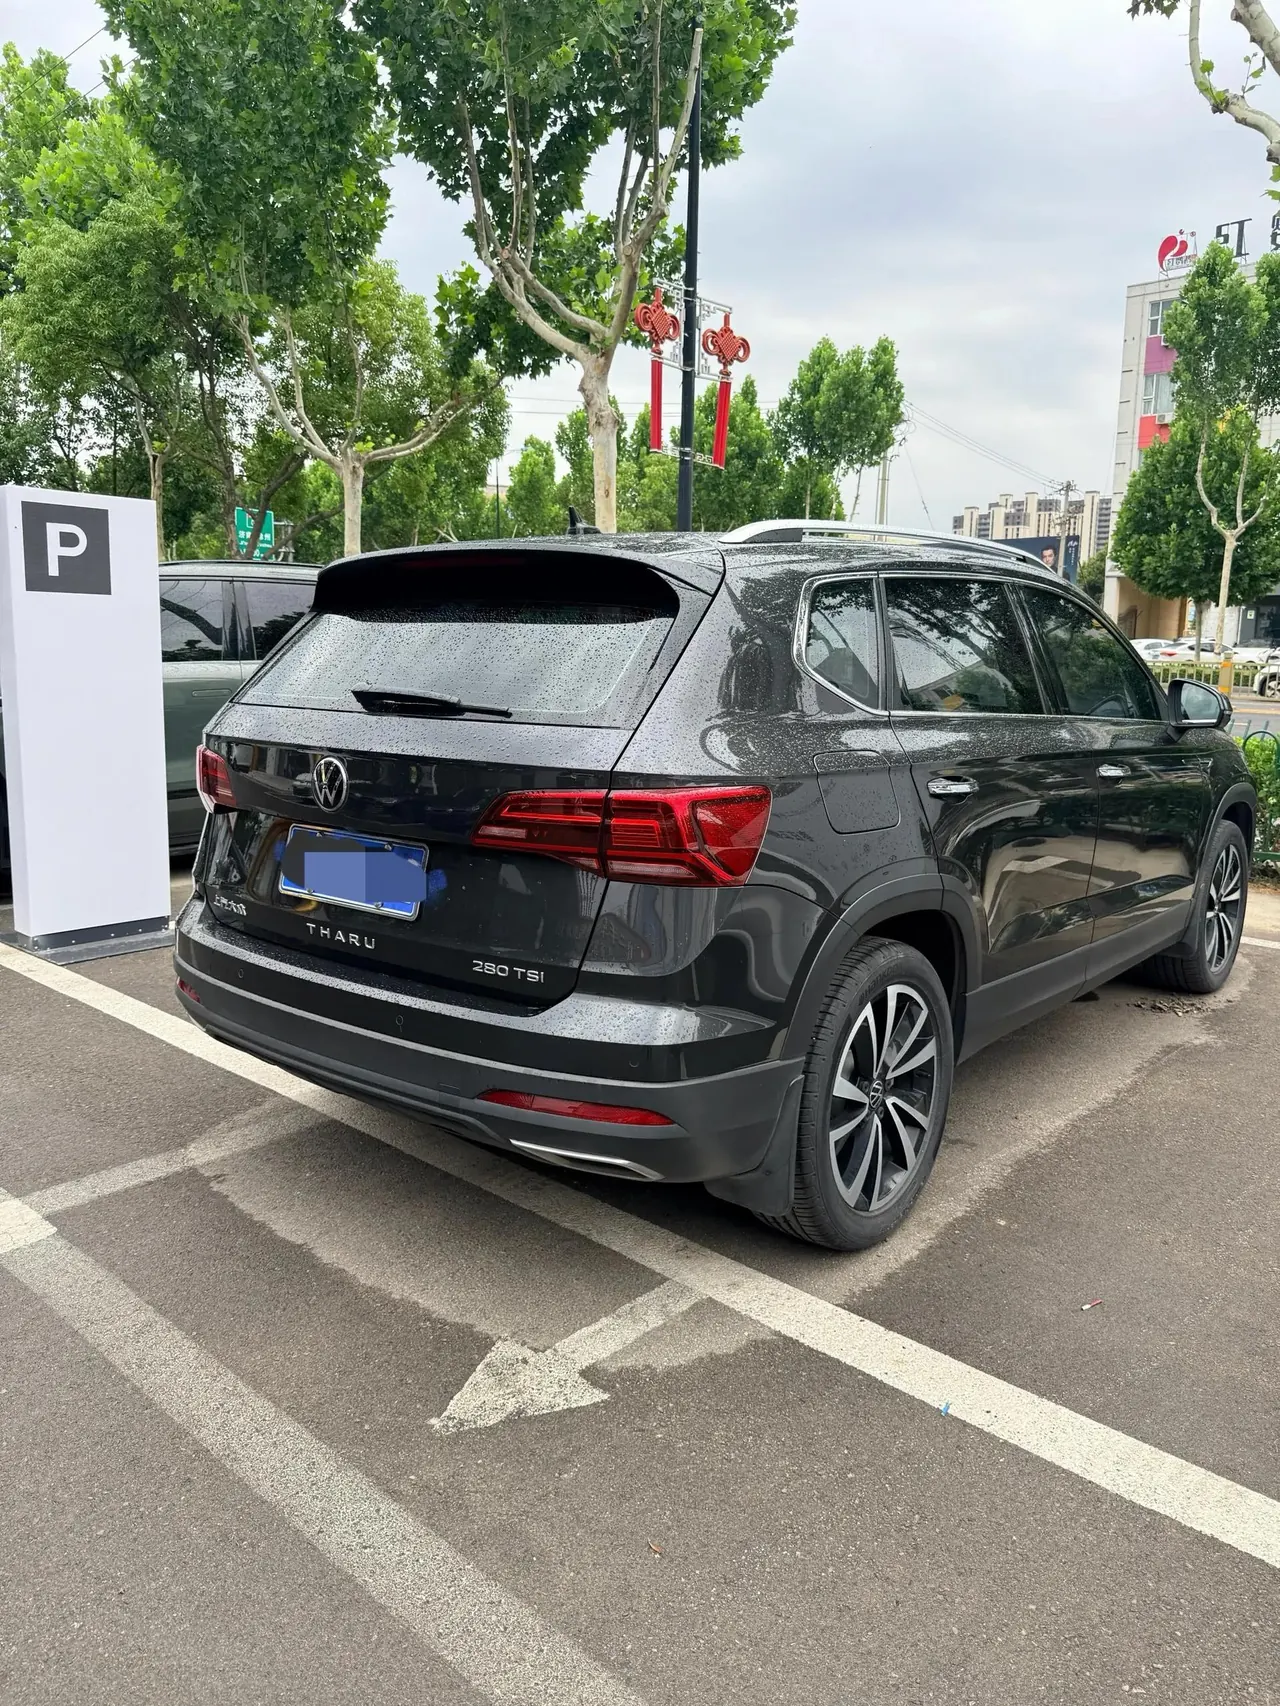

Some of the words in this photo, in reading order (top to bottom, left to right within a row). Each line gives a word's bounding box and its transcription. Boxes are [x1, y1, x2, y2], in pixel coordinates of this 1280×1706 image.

[46, 522, 87, 576] P
[213, 894, 247, 916] 上汽大众
[306, 923, 376, 950] THARU
[472, 960, 508, 977] 280
[513, 967, 545, 984] TSI
